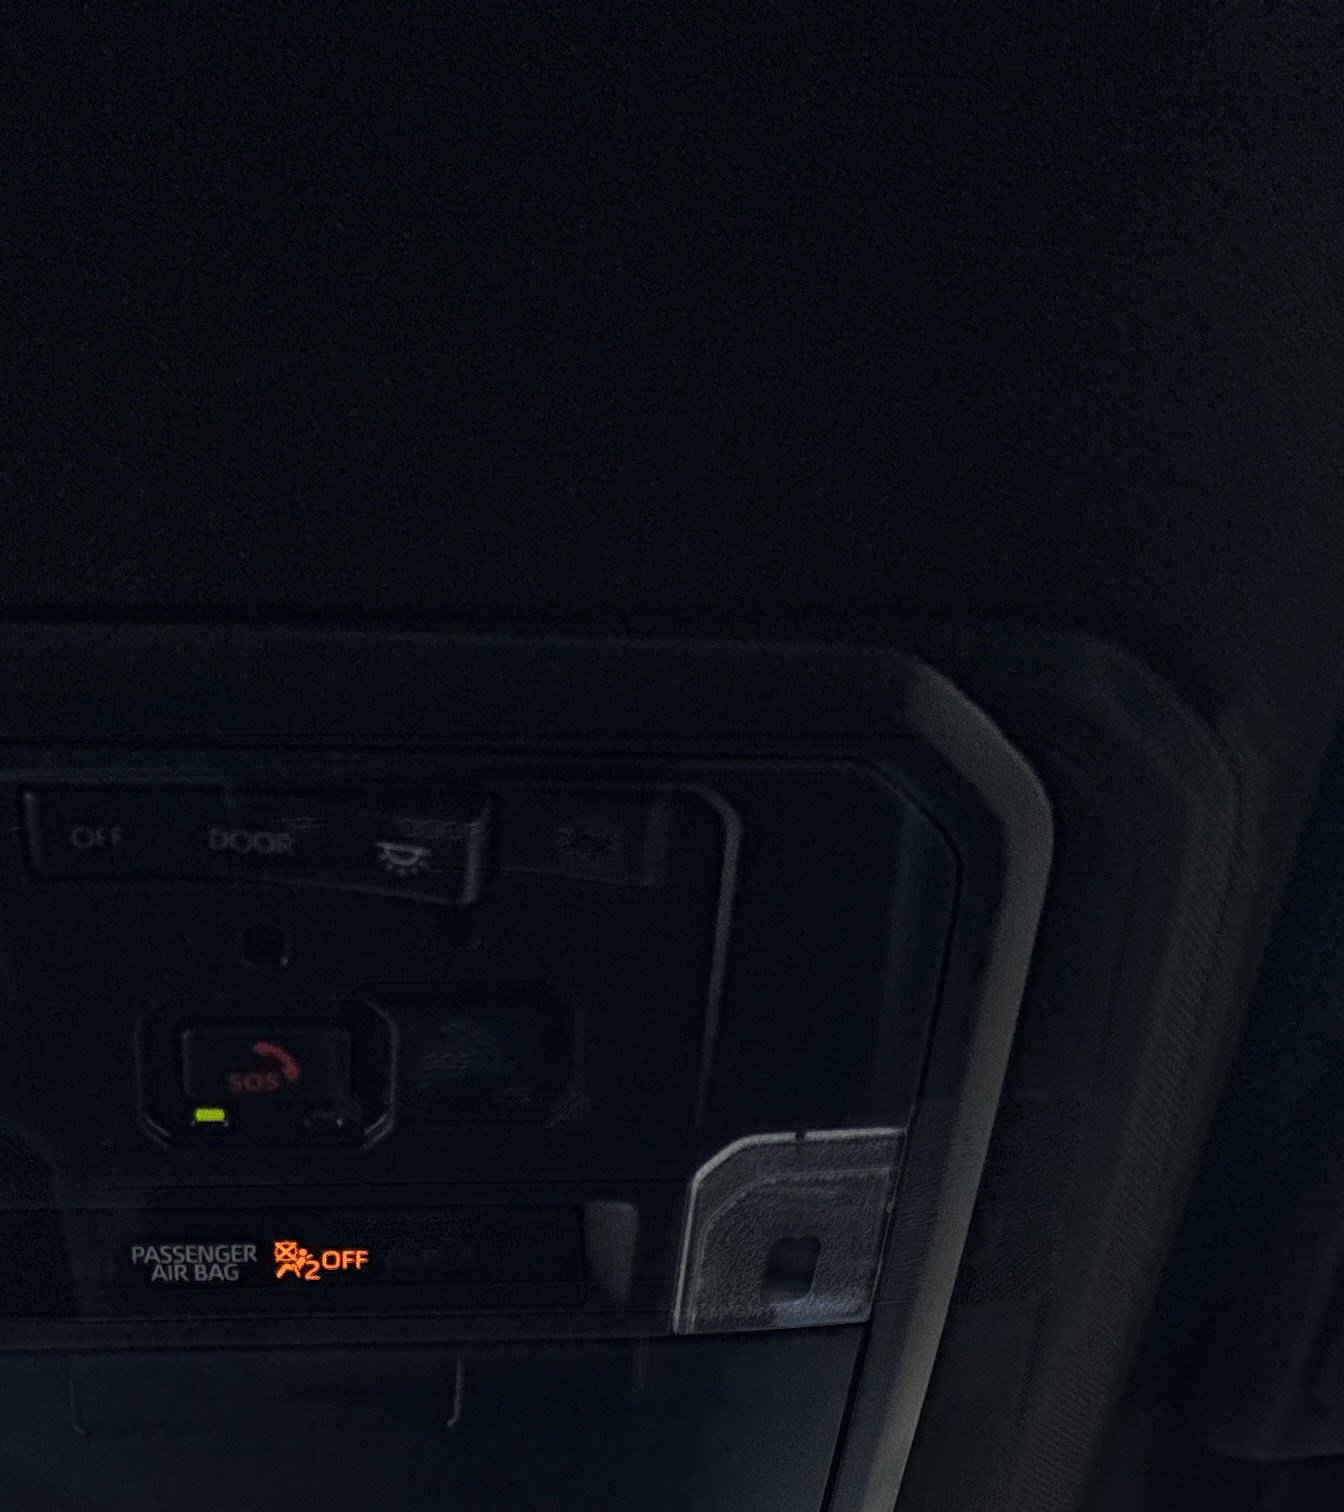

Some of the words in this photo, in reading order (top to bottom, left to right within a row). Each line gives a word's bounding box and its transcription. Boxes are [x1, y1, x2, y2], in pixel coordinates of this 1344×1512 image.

[70, 825, 122, 849] OFF
[207, 827, 295, 855] DOOR
[227, 1071, 280, 1093] SOS
[131, 1244, 257, 1265] PASSENGER
[320, 1250, 369, 1270] OFF
[151, 1264, 189, 1282] AIR
[194, 1263, 240, 1282] BAG
